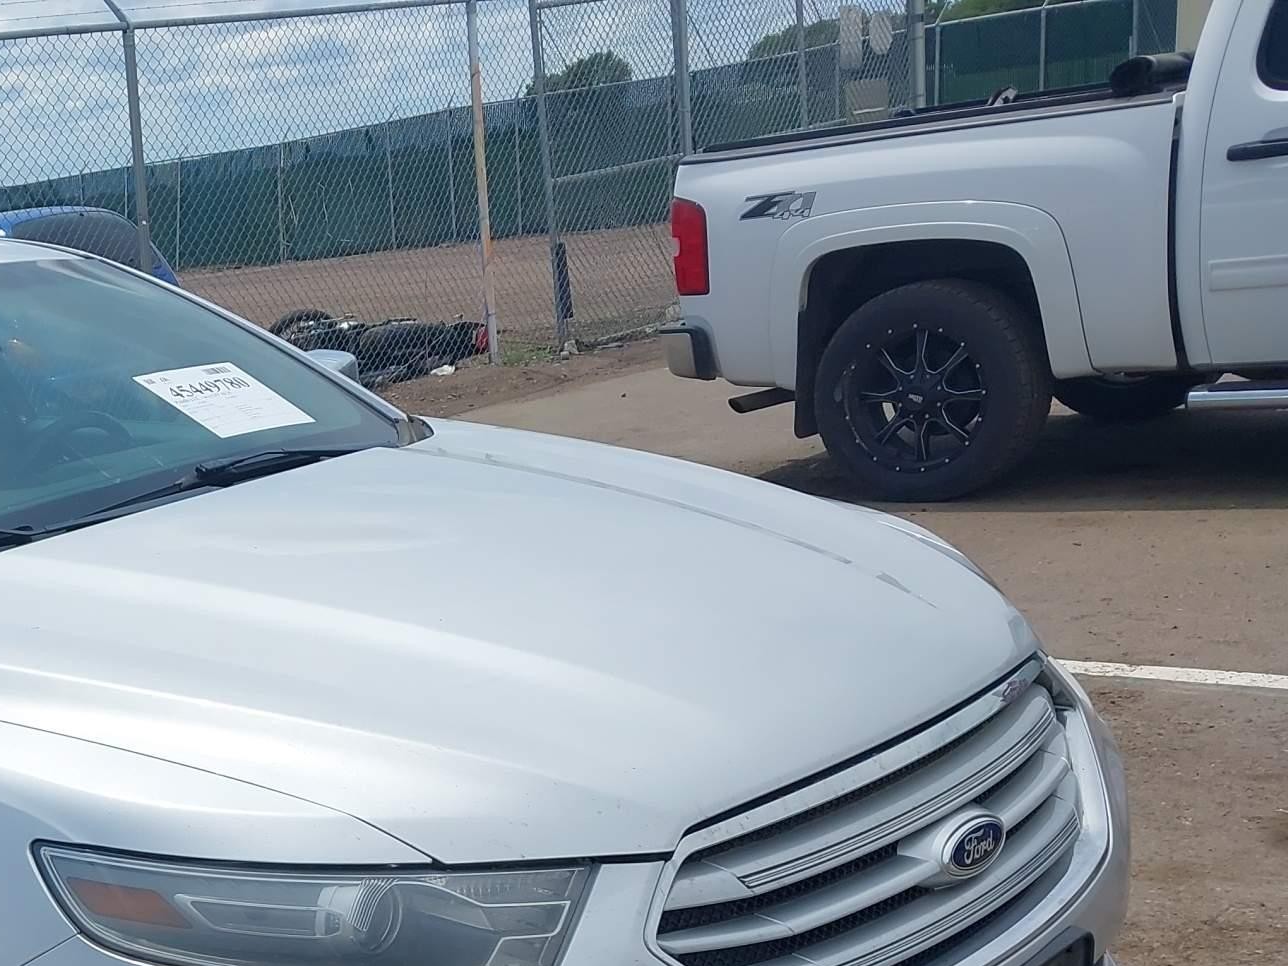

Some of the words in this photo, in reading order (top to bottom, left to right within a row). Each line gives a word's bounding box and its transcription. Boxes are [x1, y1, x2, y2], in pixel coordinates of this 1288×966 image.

[739, 190, 816, 221] Z71
[169, 376, 251, 399] 45449780
[963, 828, 995, 865] Ford
